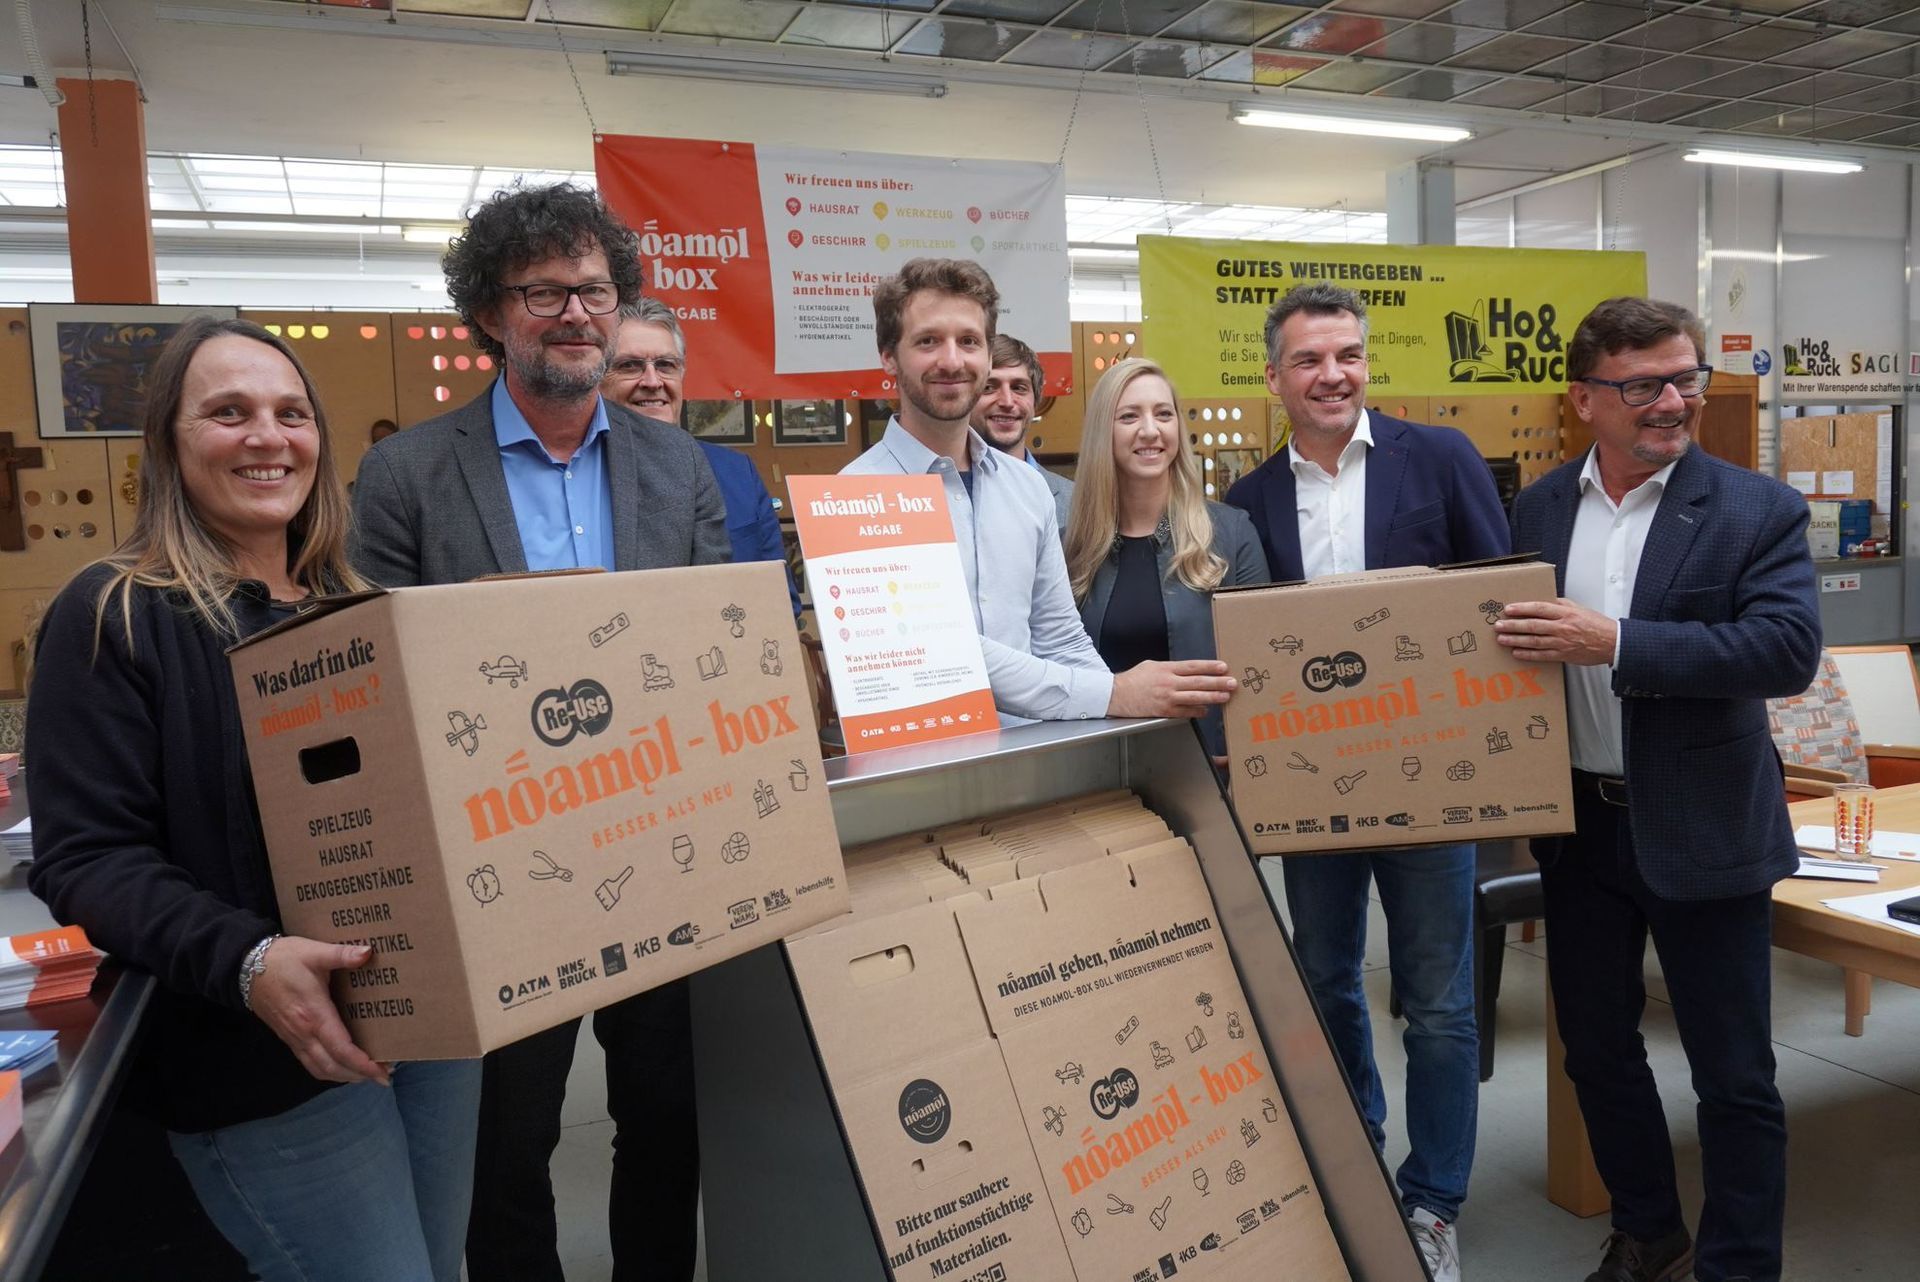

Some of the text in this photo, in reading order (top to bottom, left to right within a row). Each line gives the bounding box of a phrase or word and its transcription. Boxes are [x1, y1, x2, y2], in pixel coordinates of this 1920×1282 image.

[785, 173, 914, 191] Wir freuen uns über:
[809, 203, 860, 215] HAUSRAT
[896, 208, 953, 219] WERKZEUG
[990, 210, 1030, 221] BÜCHER
[812, 235, 867, 247] GESCHIRR
[898, 239, 957, 249] SPIELZEUG
[991, 240, 1060, 253] SPORTARTIKEL
[652, 258, 719, 290] box
[792, 271, 819, 281] Was
[822, 272, 843, 283] wir
[845, 272, 882, 283] leider
[1216, 259, 1283, 278] GUTES
[1290, 261, 1423, 282] WEITERGEBEN
[793, 285, 860, 296] annehmen
[1216, 286, 1279, 304] STATT
[799, 333, 852, 341] HYGIENEARTIKEL
[1219, 330, 1241, 344] Wir
[1369, 333, 1385, 345] mit
[1388, 332, 1427, 347] Dingen,
[1220, 349, 1237, 362] die
[1241, 349, 1259, 362] Sie
[1807, 357, 1841, 377] Ruck
[1782, 383, 1795, 393] Mit
[1797, 383, 1815, 393] Ihrer
[1817, 382, 1868, 395] Warenspende
[1870, 382, 1901, 393] schaffen
[896, 492, 936, 513] box
[859, 524, 903, 537] ABGABE
[825, 566, 841, 576] Wir
[843, 565, 872, 575] freuen
[872, 564, 888, 574] uns
[845, 585, 880, 595] HAUSRAT
[850, 606, 888, 617] GESCHIRR
[845, 647, 926, 663] Was wir leider nicht
[252, 637, 376, 699] Was darf in die
[847, 661, 891, 673] annehmen
[1311, 661, 1363, 683] Re-Use
[1453, 667, 1547, 708] box
[543, 695, 610, 732] Re-Use
[707, 694, 800, 758] box
[1337, 726, 1467, 758] BESSER ALS NEU
[592, 781, 734, 849] BESSER ALS NEU
[1447, 809, 1469, 817] VEREIN
[1513, 803, 1559, 813] lebenshilfe
[308, 807, 373, 837] SPIELZEUG
[1266, 822, 1291, 832] ATM
[1392, 815, 1416, 824] AMS
[1296, 826, 1326, 834] BRUCK
[319, 840, 374, 868] HAUSRAT
[296, 866, 415, 903] DEKOGEGENSTÄNDE
[795, 875, 835, 897] lebenshilfe
[332, 903, 392, 928] GESCHIRR
[731, 903, 755, 917] VEREIN
[733, 911, 757, 926] WAMS
[674, 924, 701, 943] AMS
[1058, 950, 1108, 982] geben,
[1159, 916, 1212, 944] nehmen
[518, 975, 552, 997] ATM
[559, 966, 598, 991] BRUCK
[1013, 941, 1214, 1018] DIESE NOAMOL-BOX SOLL WIEDERVERWENDET WERDEN
[346, 998, 415, 1020] WERKZEUG
[1200, 1052, 1264, 1106] box
[1096, 1076, 1136, 1110] Re-Use
[1141, 1126, 1229, 1190] BESSER ALS NEU
[895, 1176, 1011, 1237] Bitte nur saubere
[915, 1192, 1035, 1257] funktionstüchtige
[930, 1232, 1013, 1279] Materialien.
